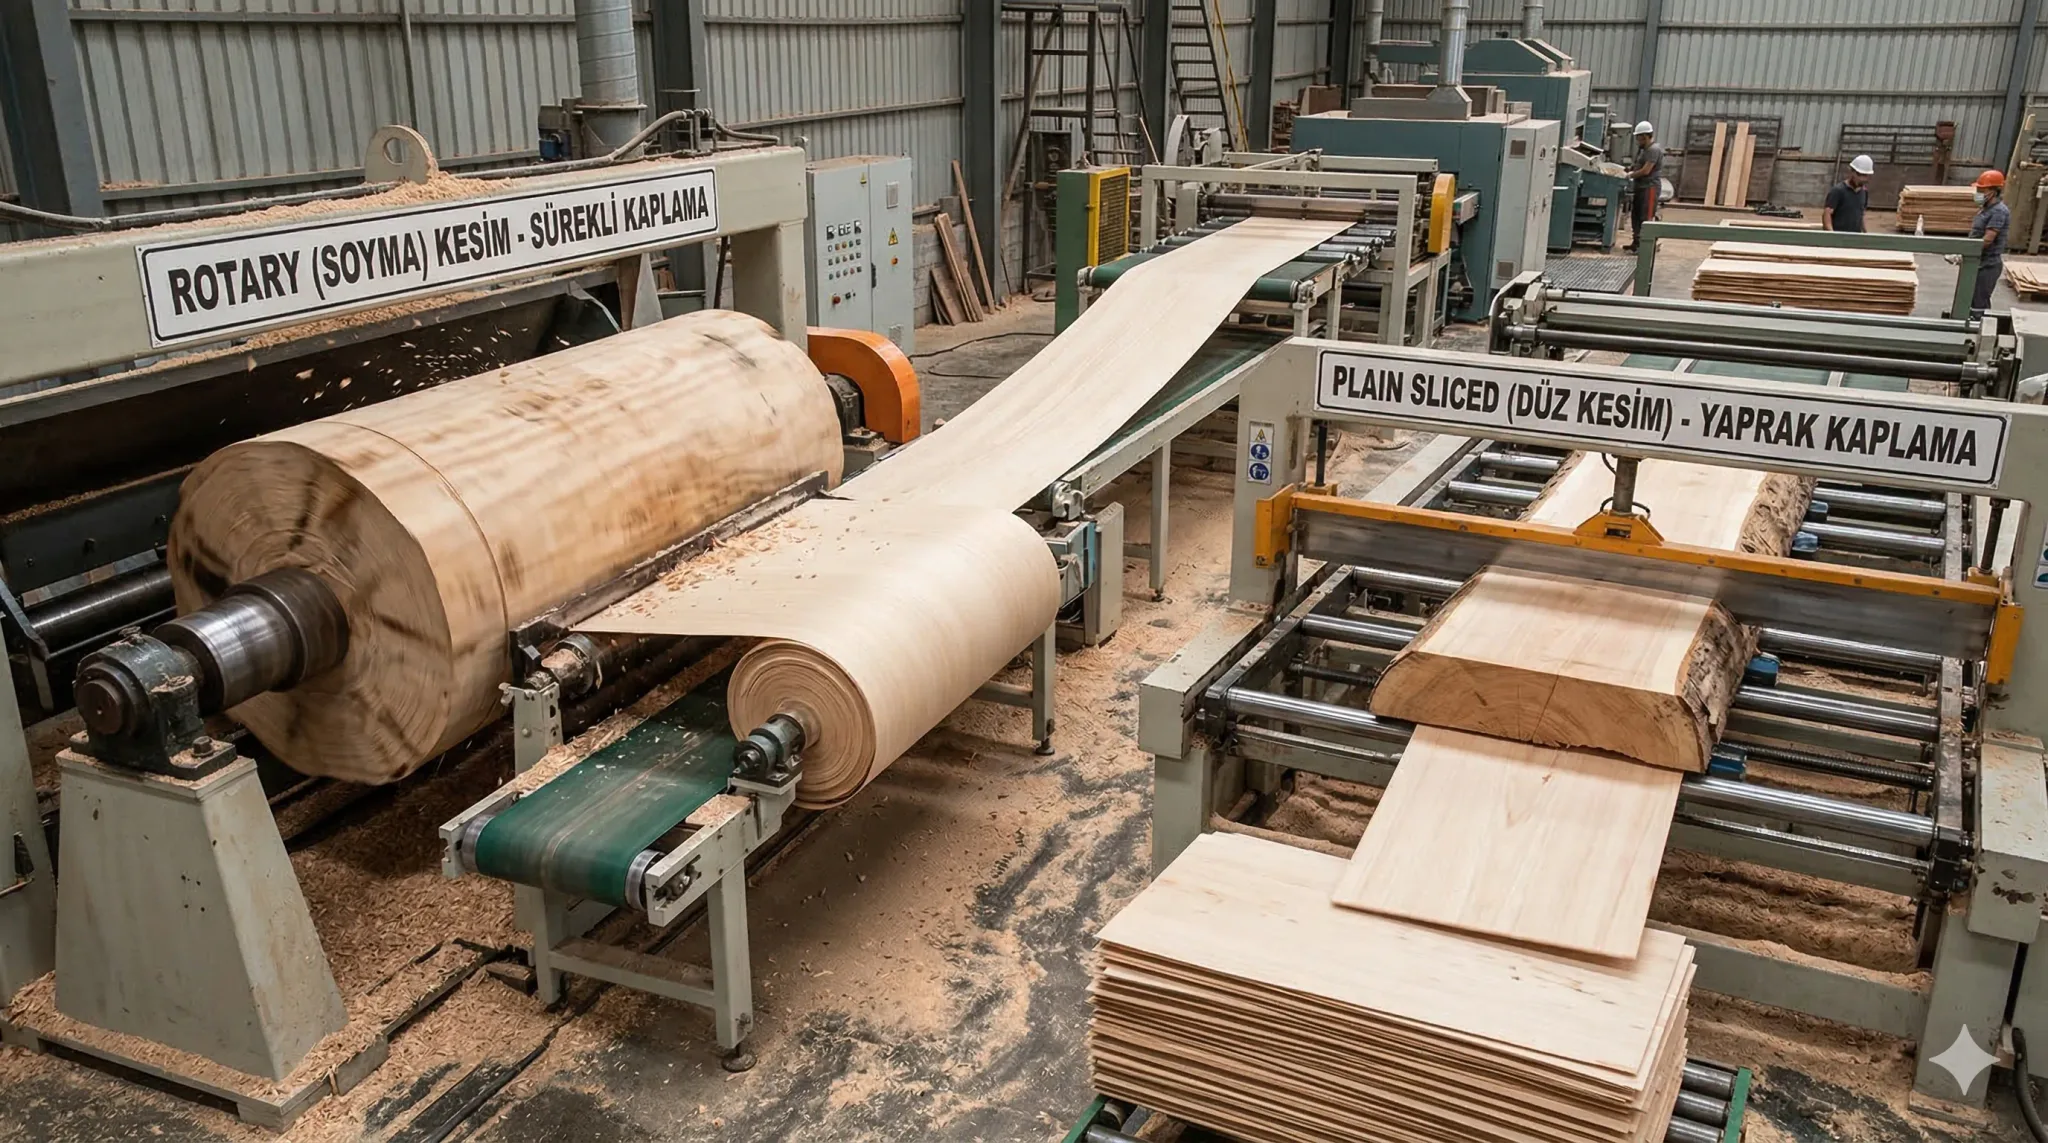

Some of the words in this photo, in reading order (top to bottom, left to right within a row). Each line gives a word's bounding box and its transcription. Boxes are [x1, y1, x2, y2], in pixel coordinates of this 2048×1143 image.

[168, 250, 300, 316] ROTARY
[312, 230, 428, 301] (SOYMA)
[434, 211, 512, 267] KESİM
[517, 233, 525, 243] -
[530, 191, 619, 250] SÜREKLİ
[623, 185, 709, 232] KAPLAMA
[1333, 365, 1404, 403] PLAIN
[1410, 373, 1500, 413] SLICED
[1507, 379, 1571, 425] (DÜZ
[1576, 388, 1673, 441] KESİM)
[1681, 418, 1690, 427] -
[1701, 402, 1820, 449] YAPRAK
[1824, 415, 1977, 467] KAPLAMA
